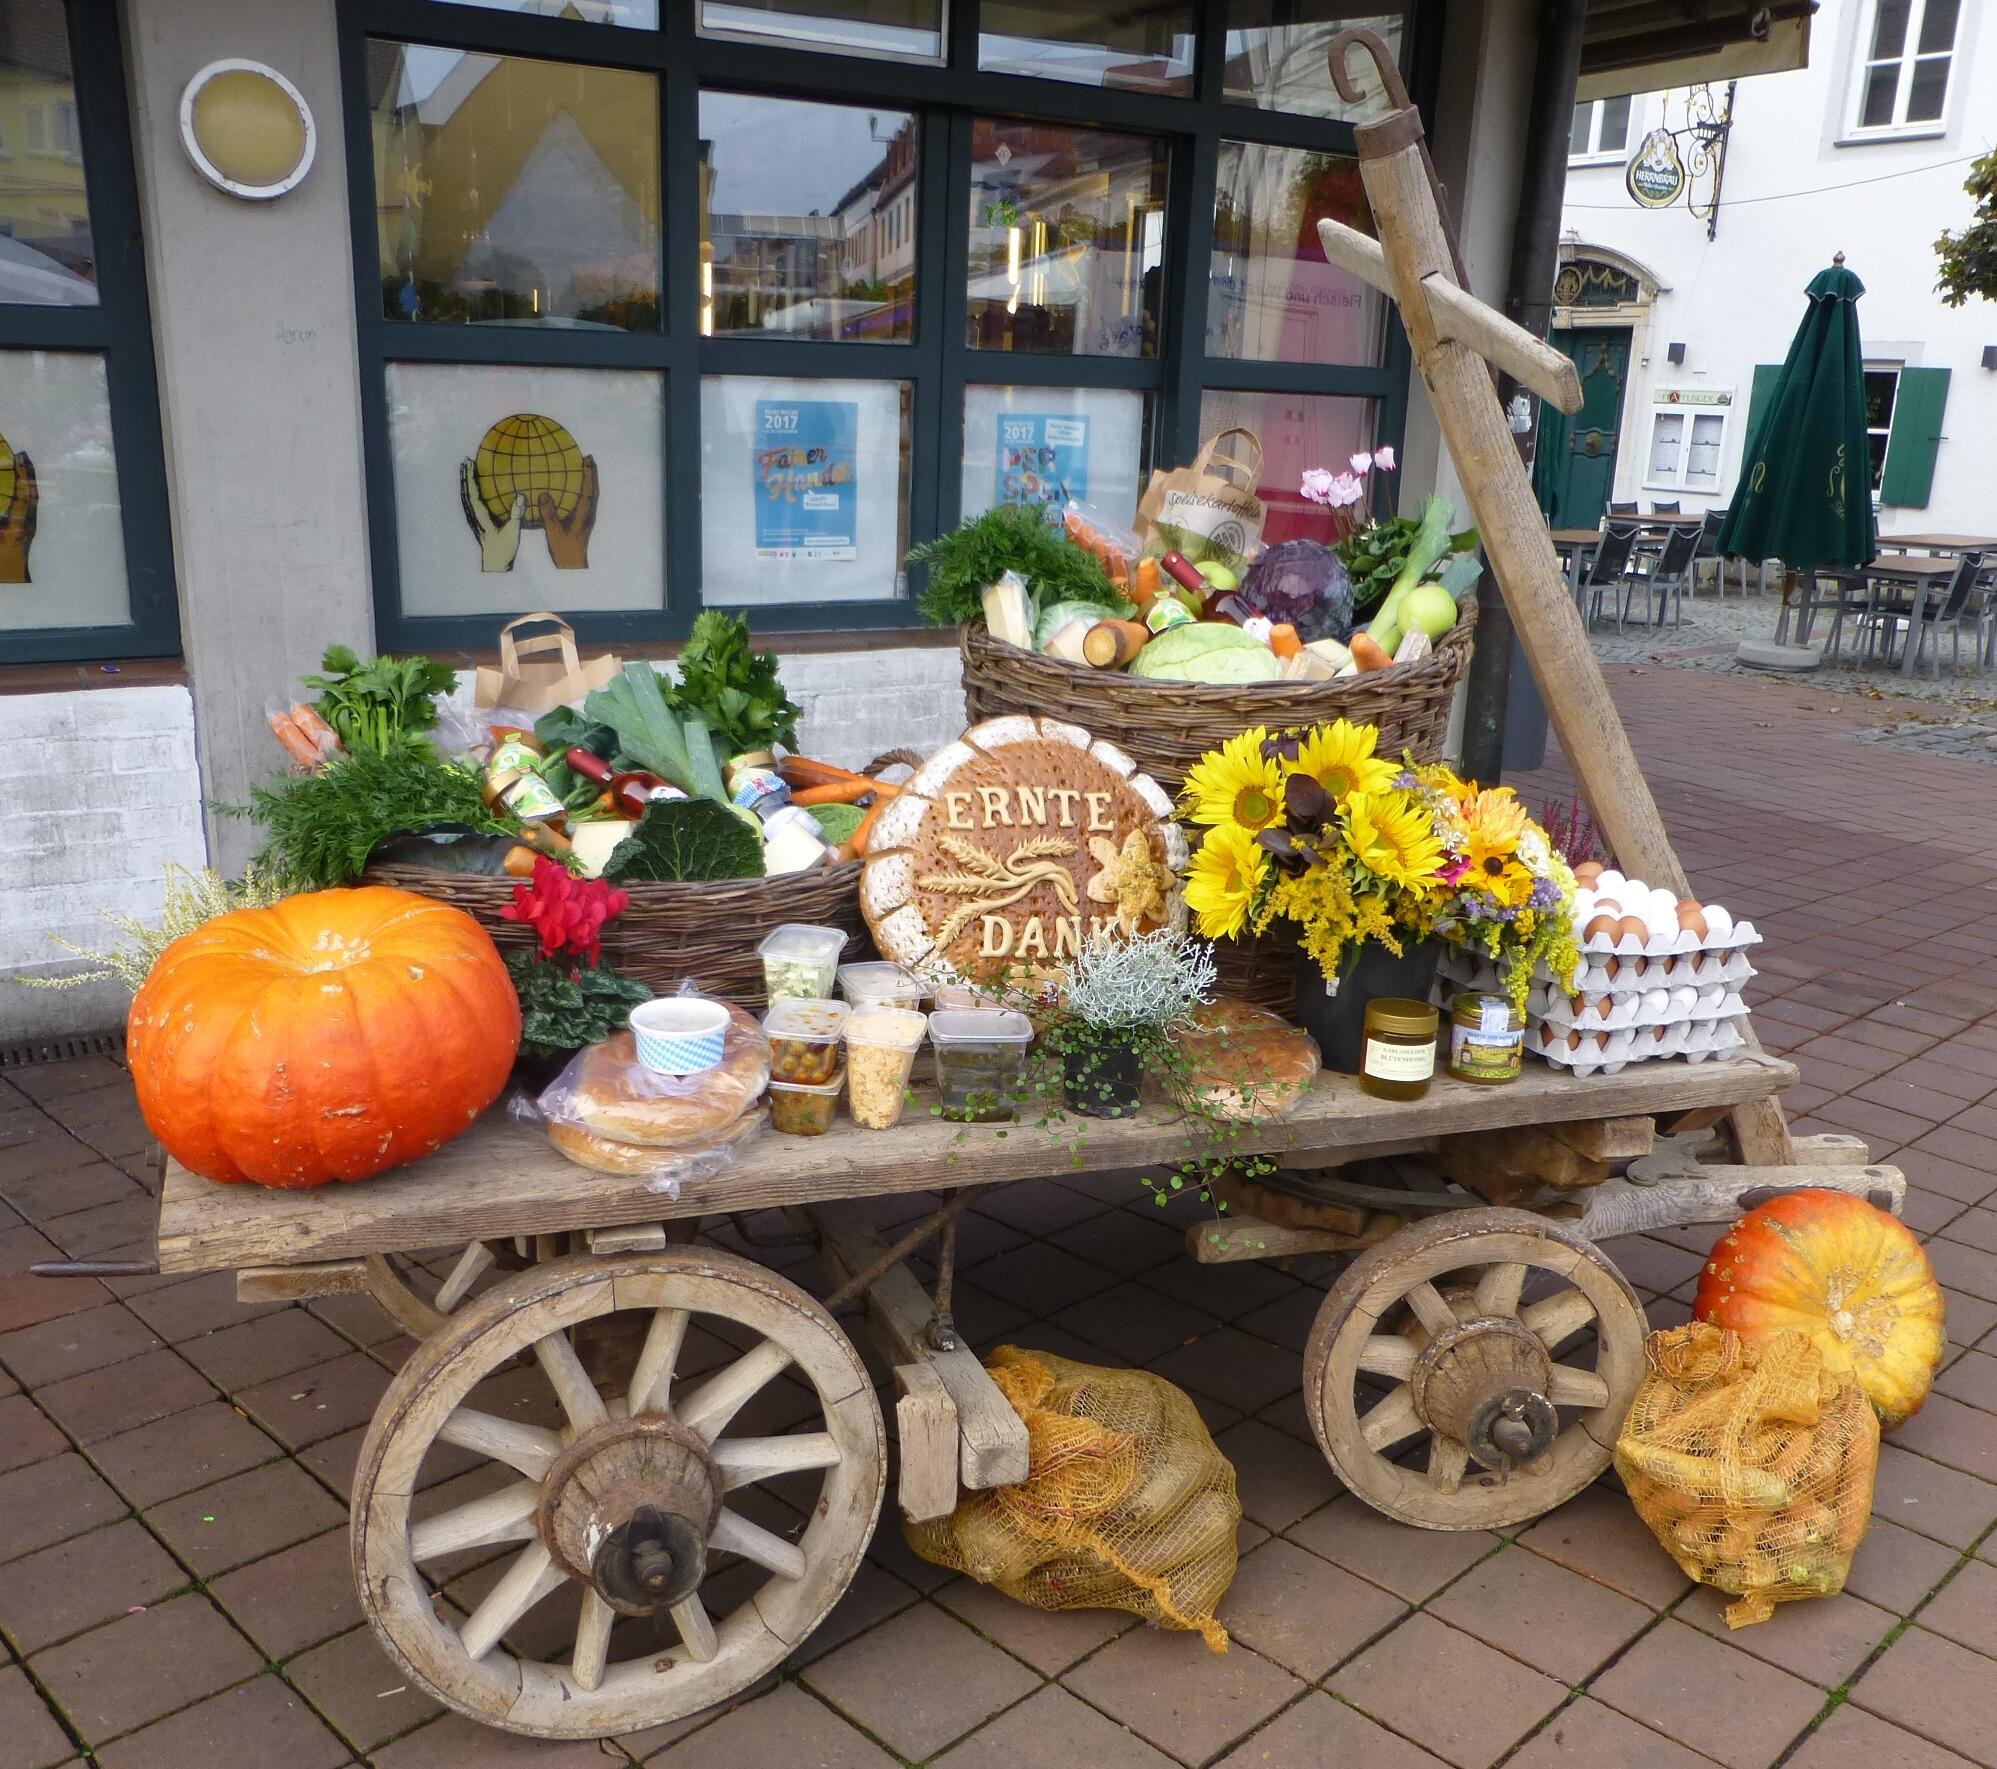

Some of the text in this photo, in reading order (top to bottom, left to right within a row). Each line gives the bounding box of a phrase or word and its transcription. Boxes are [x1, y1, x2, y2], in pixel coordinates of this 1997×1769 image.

[764, 415, 799, 429] 2017
[1004, 427, 1035, 440] 2017
[944, 785, 1116, 832] ERNTE
